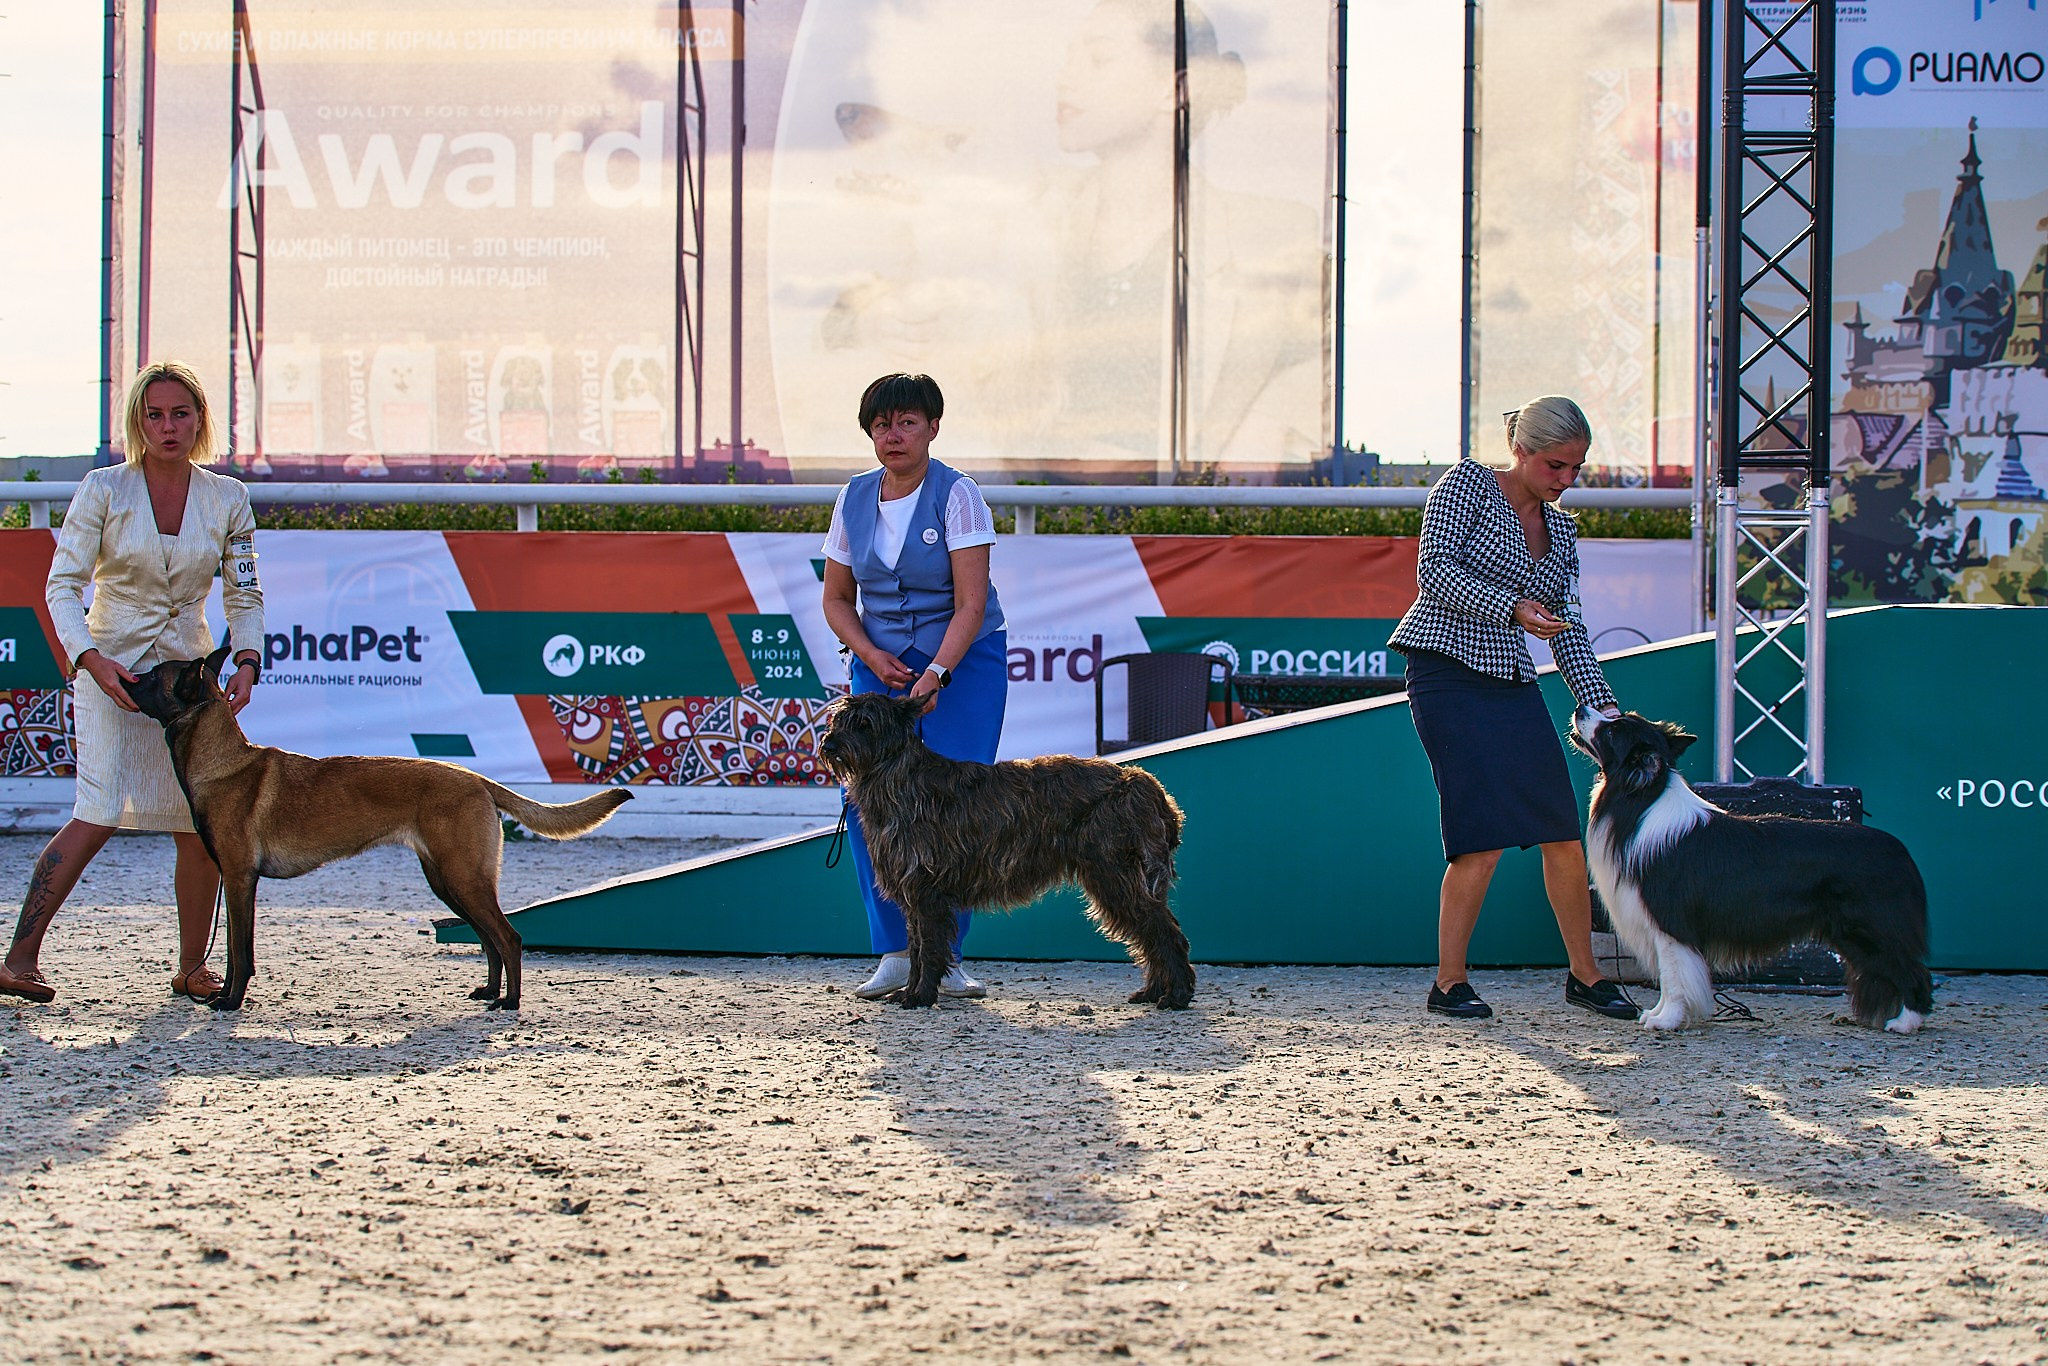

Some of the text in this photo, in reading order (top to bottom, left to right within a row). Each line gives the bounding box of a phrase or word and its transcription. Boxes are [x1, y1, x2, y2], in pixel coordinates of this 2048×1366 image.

[177, 30, 242, 51] СУХИЕ
[269, 30, 379, 50] ВЛАЖНЫЕ
[385, 29, 458, 50] КОРМА
[463, 28, 635, 50] СУПЕРПРЕМИУМ
[640, 27, 727, 49] КЛАССА
[317, 102, 617, 119] QUALITY FOR CHAMPIONS
[215, 100, 663, 210] Award
[263, 233, 353, 260] КАЖДЫЙ
[358, 236, 450, 259] ПИТОМЕЦ
[471, 236, 507, 258] ЭТО
[514, 235, 611, 260] ЧЕМПИОН,
[323, 262, 548, 289] ДОСТОЙНЫЙ НАГРАДЫ!
[346, 349, 368, 442] Award
[459, 349, 488, 447] Award
[574, 349, 602, 447] Award
[221, 625, 422, 670] phaPet
[751, 628, 763, 644] 8
[776, 628, 789, 644] 9
[589, 644, 646, 666] РКФ
[751, 649, 800, 660] ИЮНЯ
[1007, 633, 1102, 683] ard
[1251, 649, 1387, 677] РОССИЯ
[358, 675, 422, 688] РАЦИОНЫ
[764, 665, 803, 678] 2024
